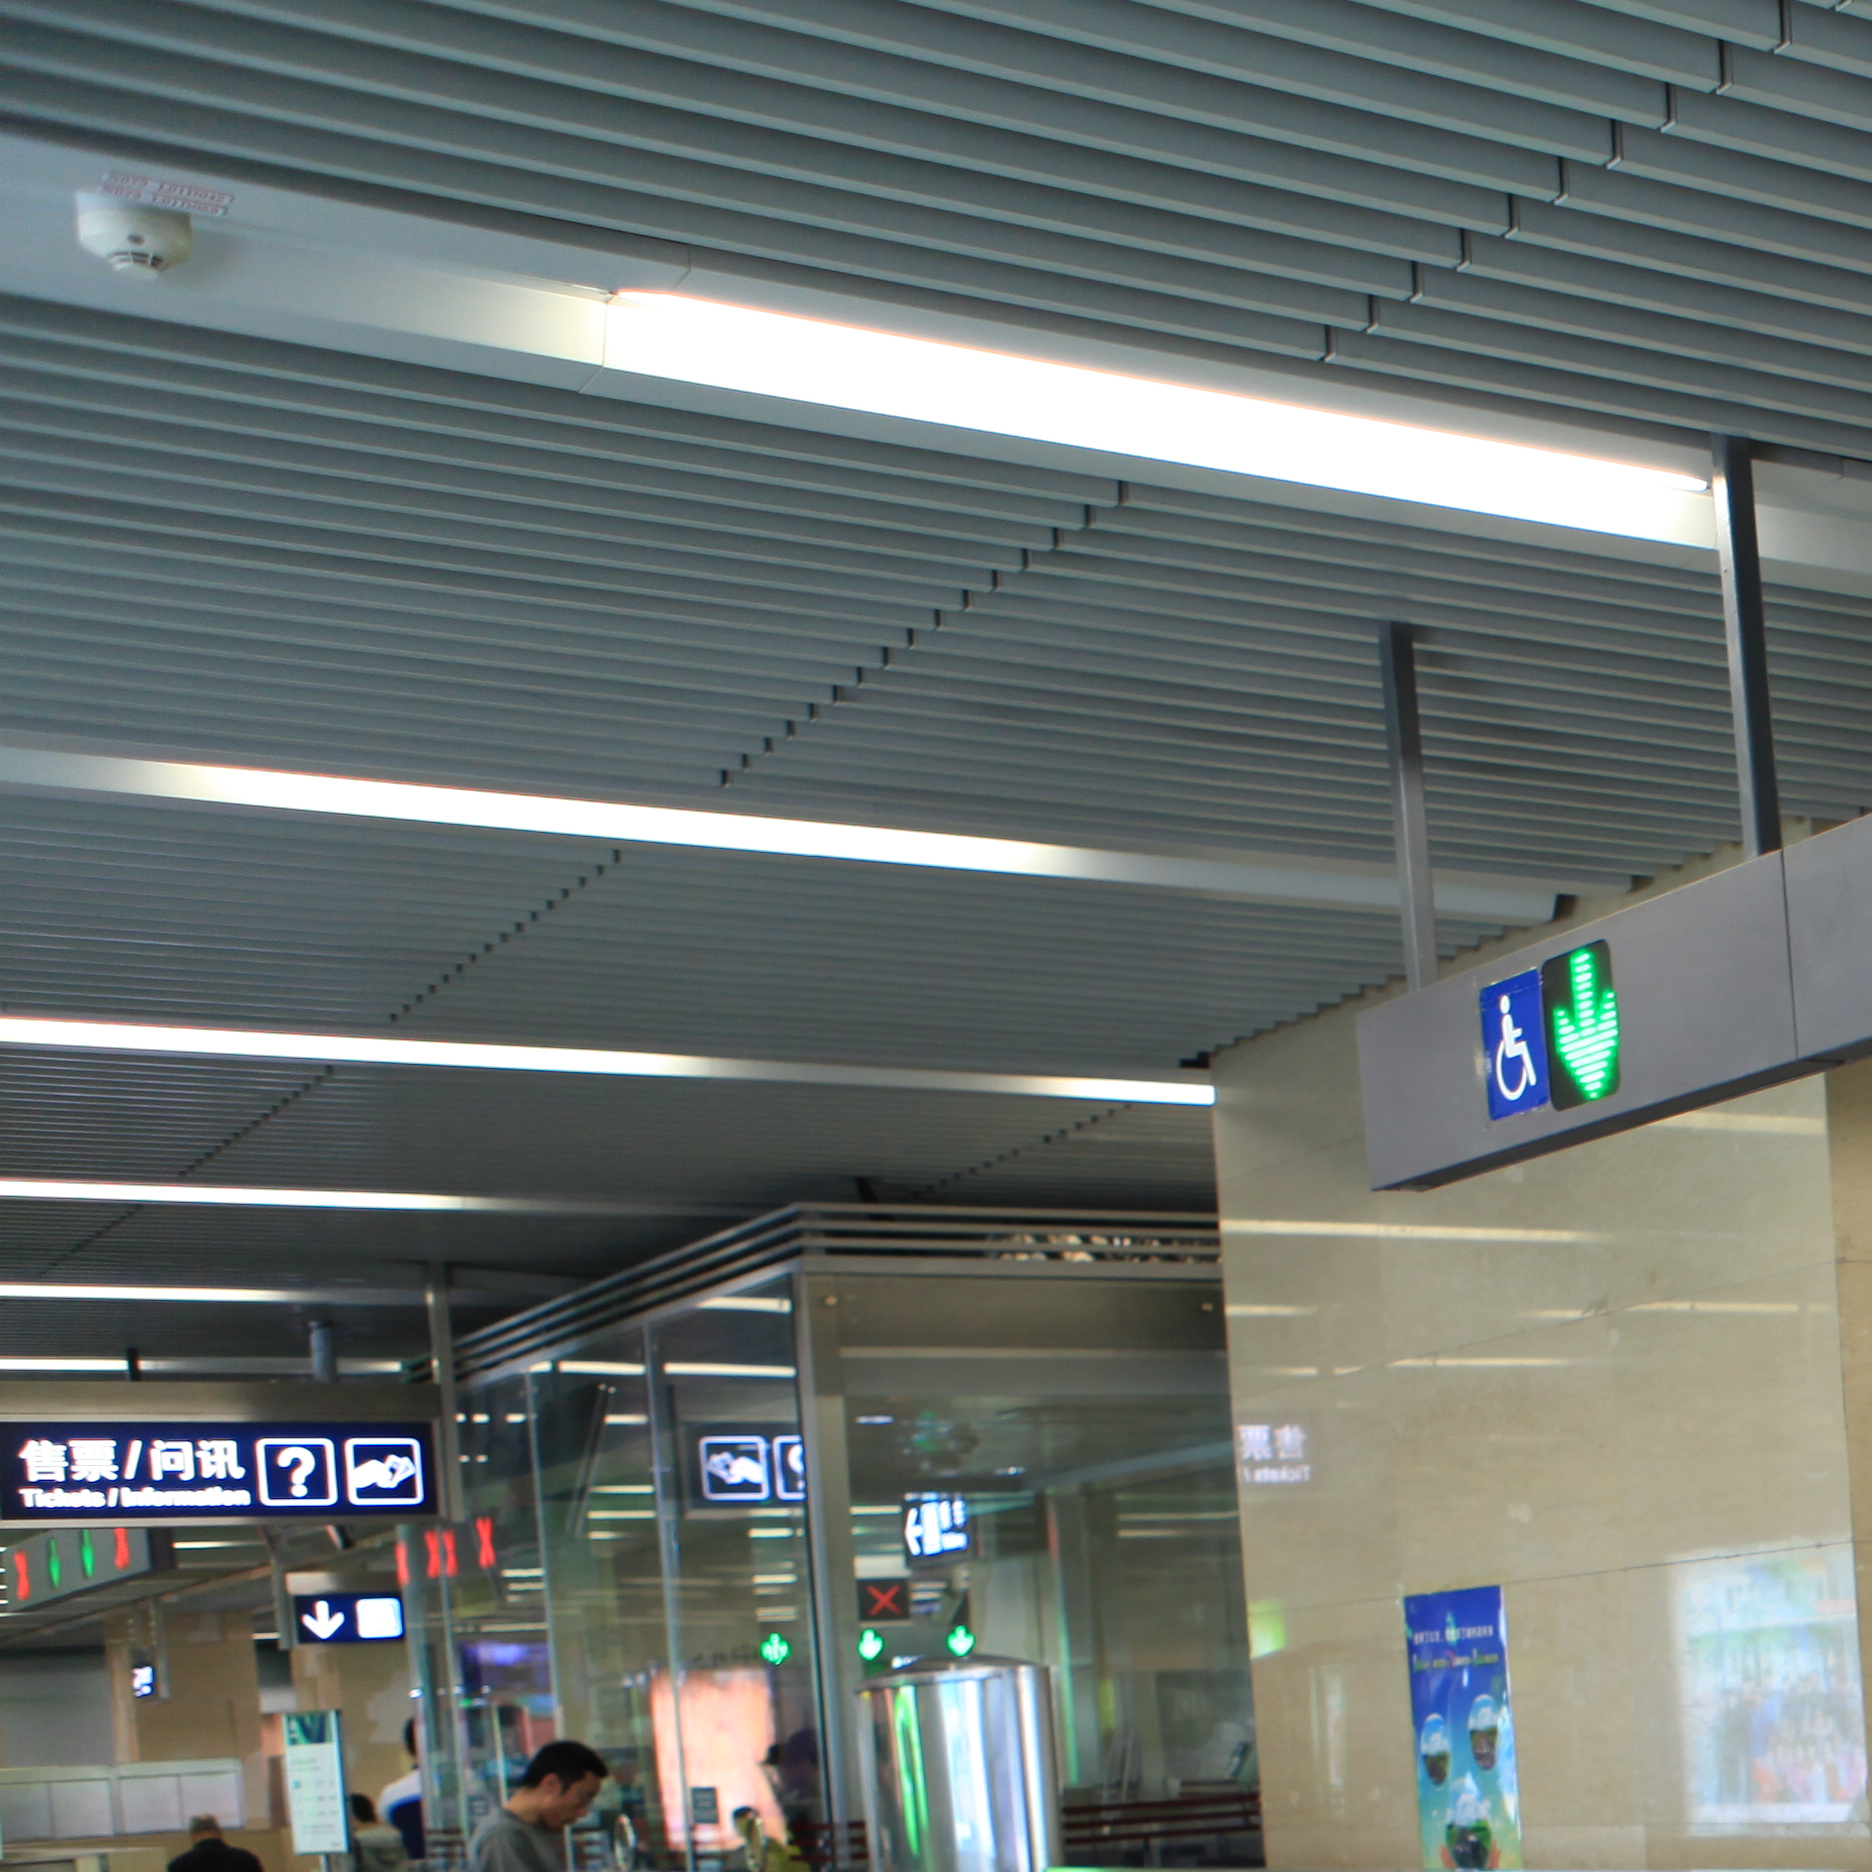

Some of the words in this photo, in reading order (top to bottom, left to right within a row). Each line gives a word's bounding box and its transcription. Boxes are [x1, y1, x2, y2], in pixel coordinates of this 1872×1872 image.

[17, 1437, 246, 1484] 售票/问讯
[17, 1486, 107, 1509] Tickets
[120, 1485, 252, 1509] Information
